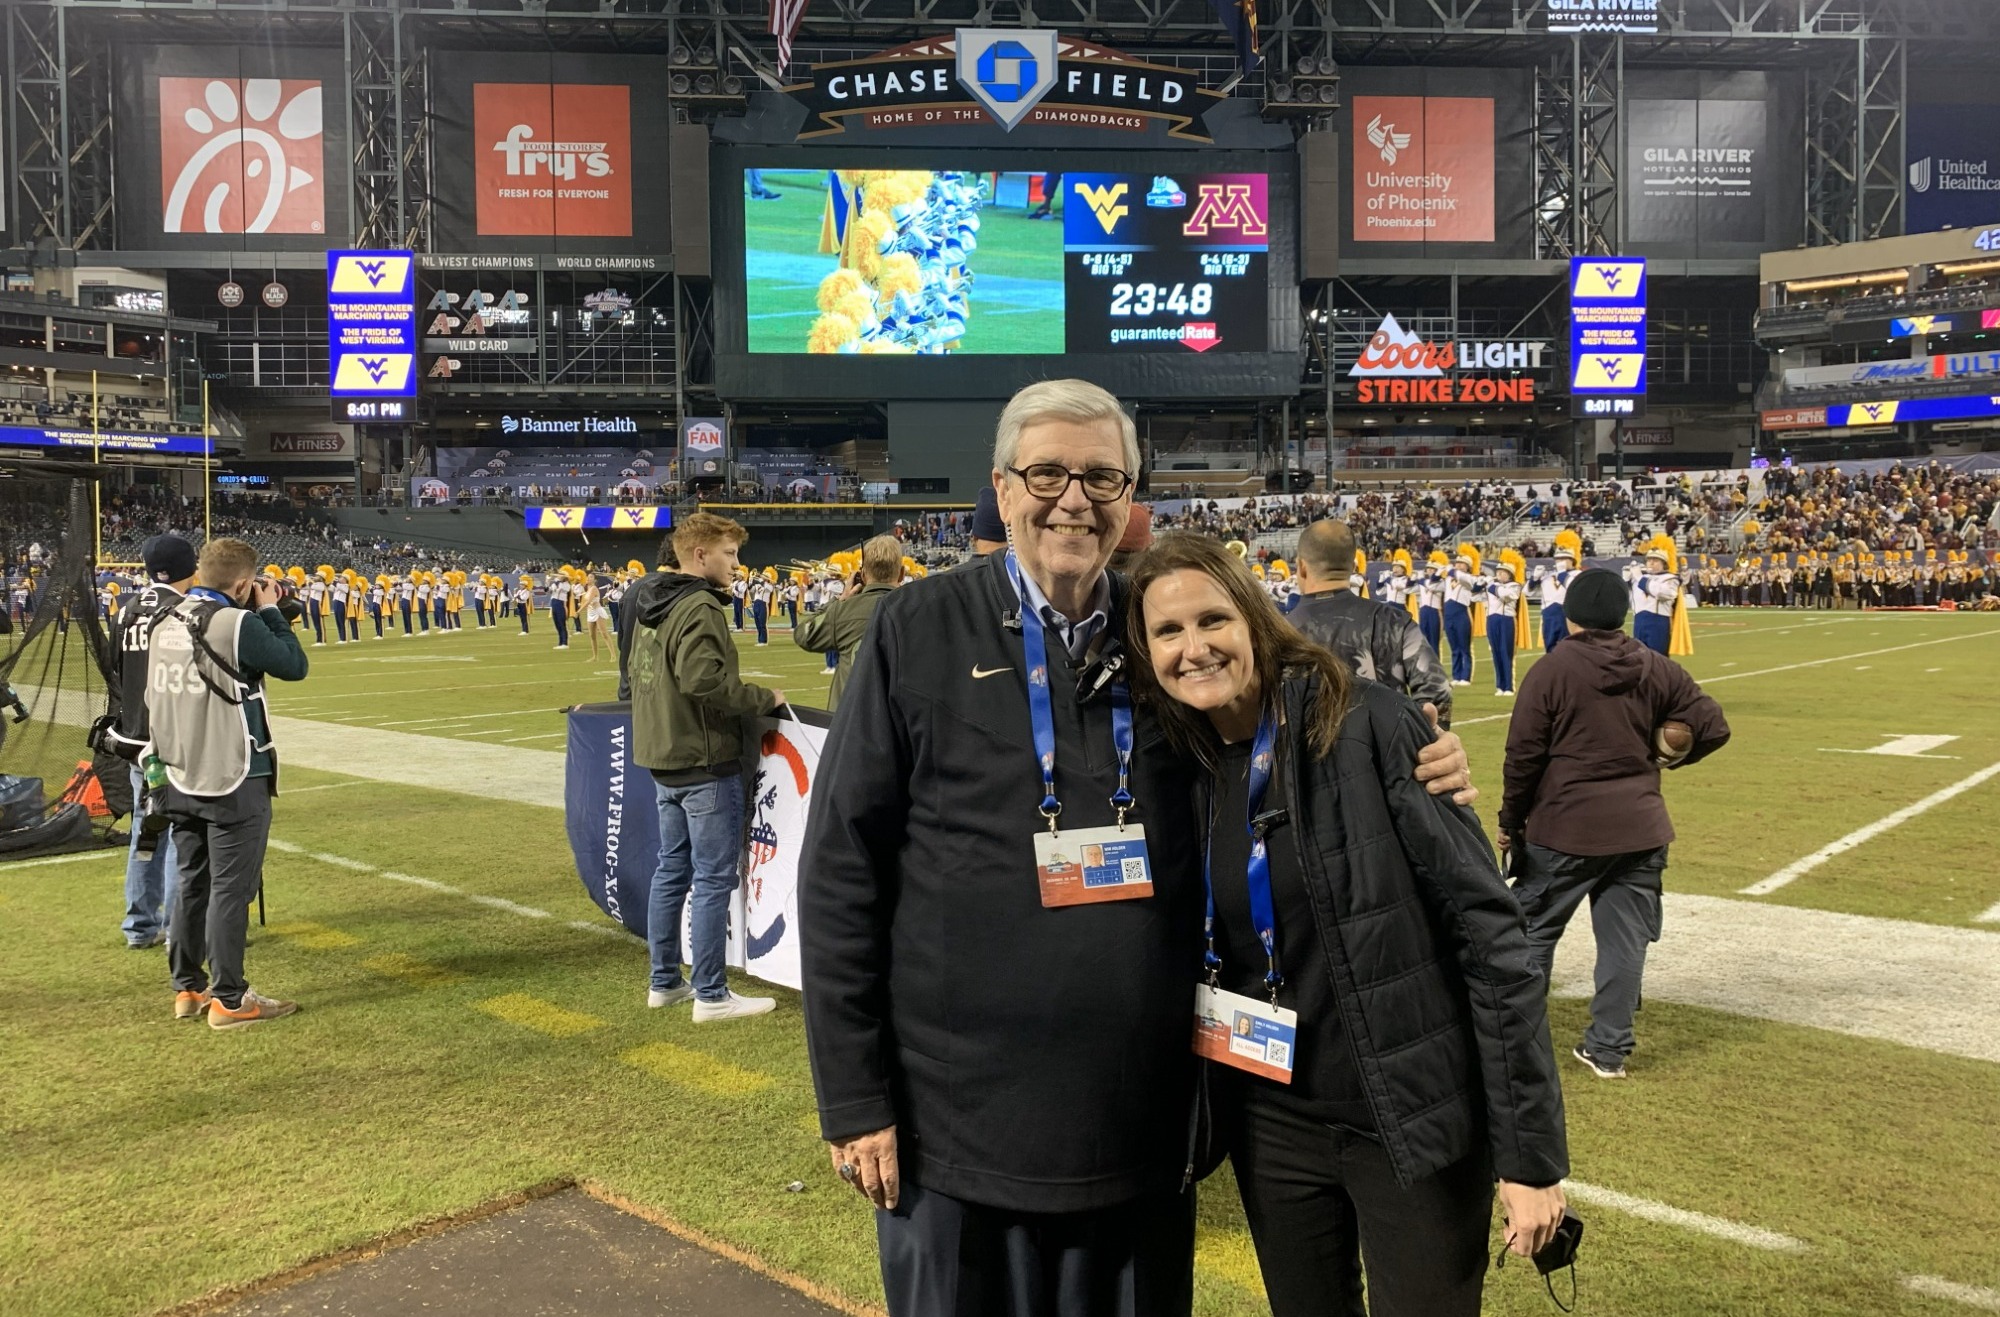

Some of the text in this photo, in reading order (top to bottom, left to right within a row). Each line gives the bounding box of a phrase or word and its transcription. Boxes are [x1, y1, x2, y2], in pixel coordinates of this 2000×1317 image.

[1597, 0, 1658, 10] RIVER
[1548, 13, 1658, 21] HOTELS & CASINOS
[829, 67, 1183, 104] CHASE FIELD
[873, 109, 1142, 129] HOME OF THE DIAMONDBACKS
[493, 124, 611, 181] fry's
[1643, 148, 1751, 162] GILA RIVER
[1938, 159, 1988, 175] United
[1366, 171, 1452, 193] University
[499, 188, 609, 199] FRESH FOR EVERYONE
[1366, 193, 1457, 210] of Phoenix
[1183, 184, 1267, 236] M
[1367, 216, 1436, 227] Phoenix.edu
[422, 256, 534, 268] NL WEST CHAMPIONS
[557, 257, 656, 269] WORLD CHAMPIONS
[1112, 264, 1124, 275] 12
[1225, 264, 1246, 275] TEN
[1110, 282, 1213, 316] 23:48
[330, 304, 414, 312] THE MOUNTAINEER
[1571, 307, 1588, 315] THE
[334, 312, 410, 320] MARCHING BAND
[342, 328, 401, 336] THE PRIDE OF
[1581, 329, 1599, 337] THE
[340, 336, 405, 345] WEST VIRGINIA
[449, 339, 509, 351] WILD CARD
[1579, 337, 1601, 345] WEST
[1357, 329, 1545, 370] Coors LIGHT
[1357, 378, 1535, 403] STRIKE ZONE
[347, 402, 402, 417] 8:01 PM
[1613, 399, 1634, 413] PM
[521, 416, 637, 432] Banner Health
[112, 434, 149, 443] MARCHING
[150, 435, 170, 444] BAND
[273, 435, 294, 450] M
[690, 432, 719, 445] FAN
[1636, 433, 1672, 443] FITNESS
[107, 440, 126, 448] WEST
[127, 441, 157, 449] VIRGINIA
[297, 439, 338, 450] FITNESS
